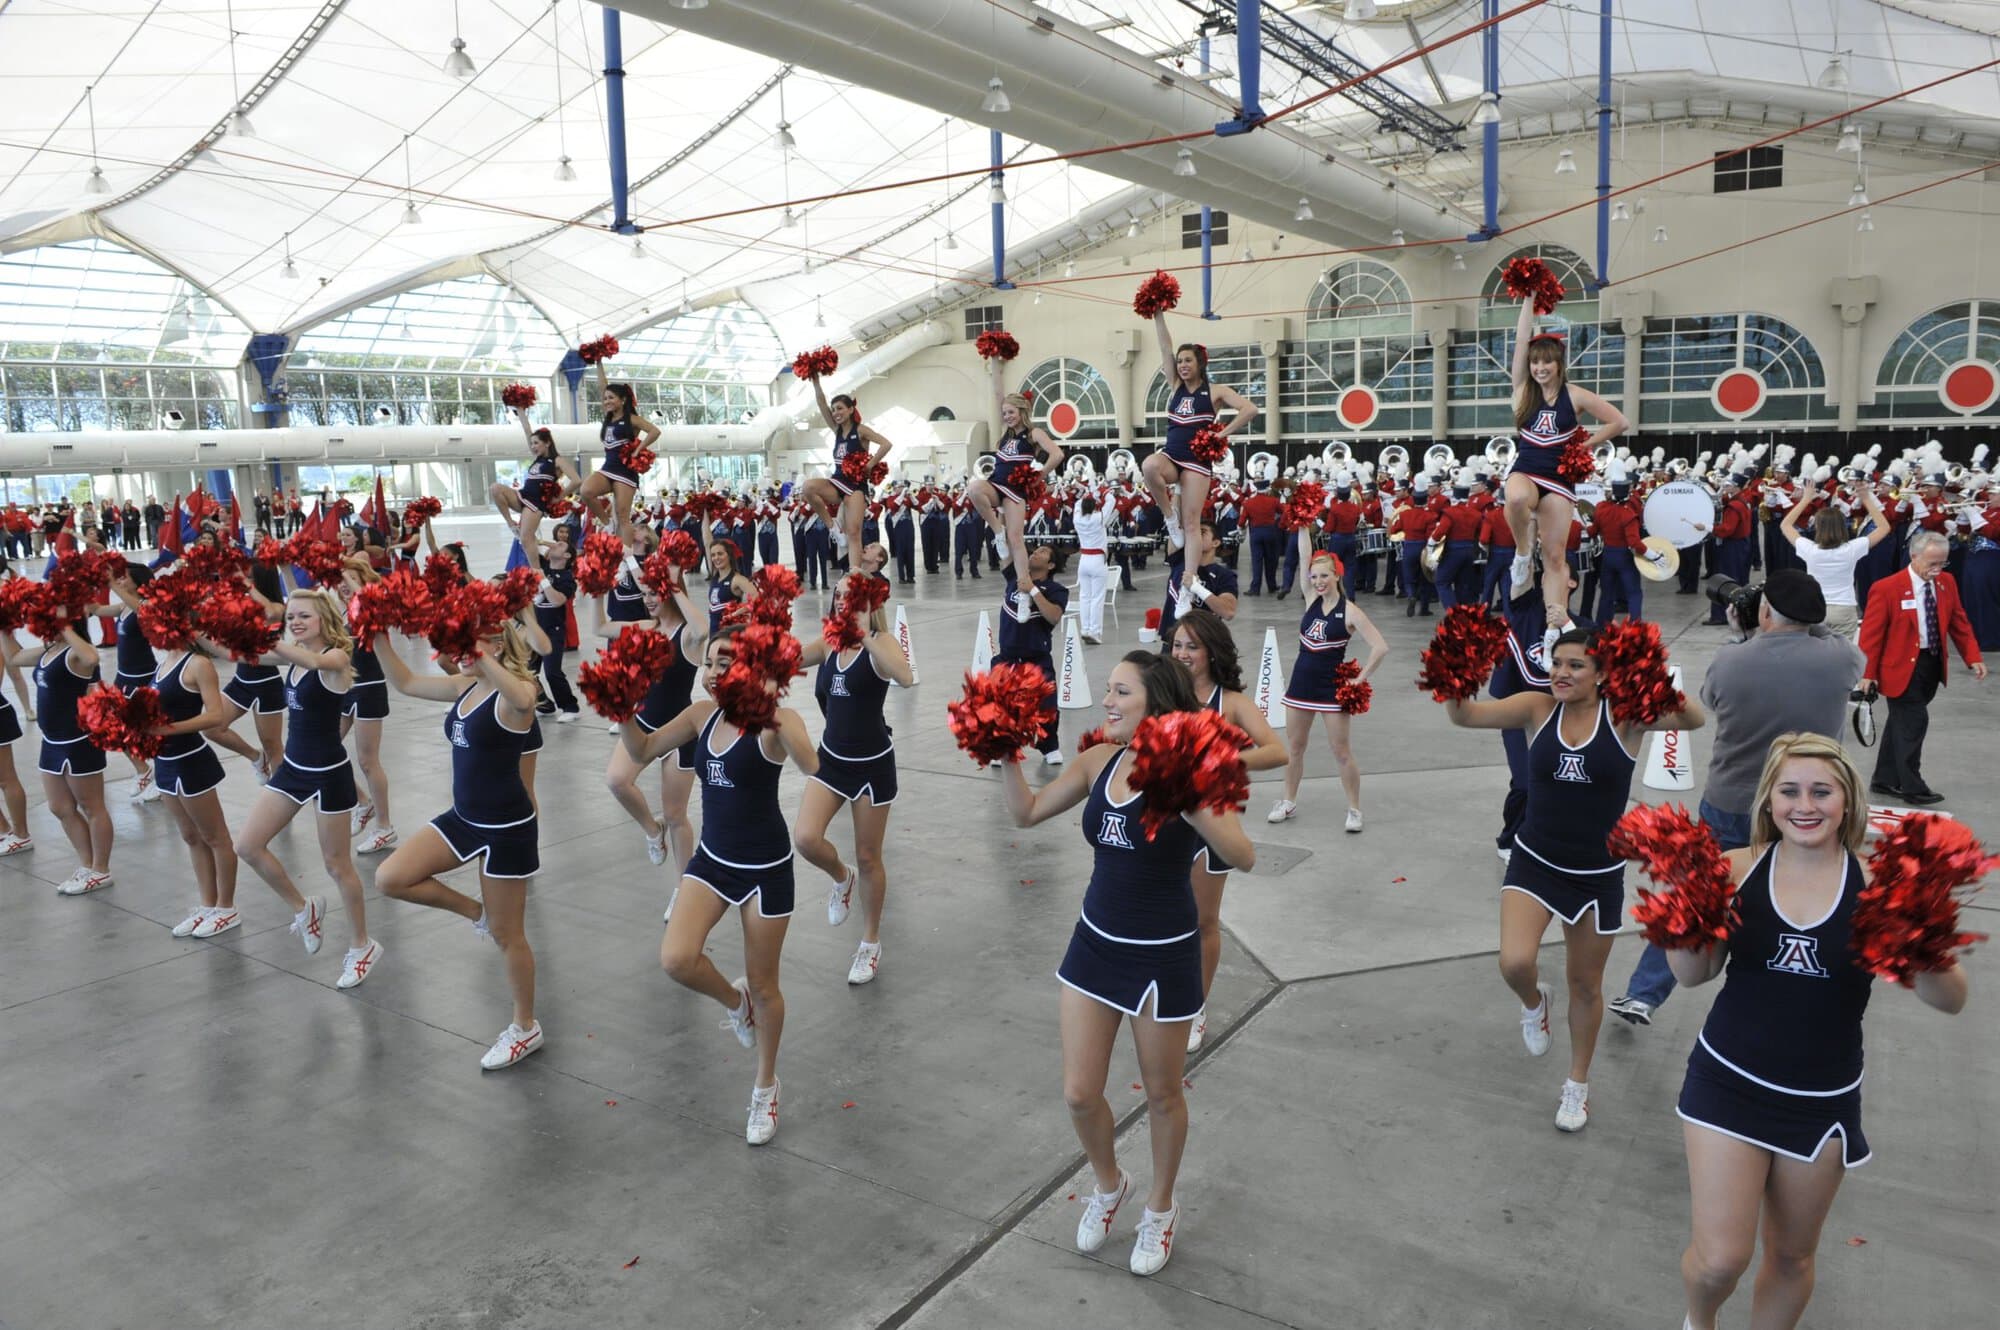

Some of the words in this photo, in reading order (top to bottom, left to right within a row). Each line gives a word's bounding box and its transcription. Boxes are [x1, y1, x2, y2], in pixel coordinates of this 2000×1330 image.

[1175, 397, 1195, 416] A
[1531, 410, 1559, 436] A
[1001, 439, 1020, 455] A
[1305, 618, 1328, 642] A
[1062, 636, 1073, 702] BEARDOWN
[830, 674, 850, 696] A
[450, 720, 469, 748] A
[706, 760, 735, 788] A
[1553, 753, 1592, 783] A
[1097, 811, 1134, 849] A
[1767, 933, 1829, 978] A
